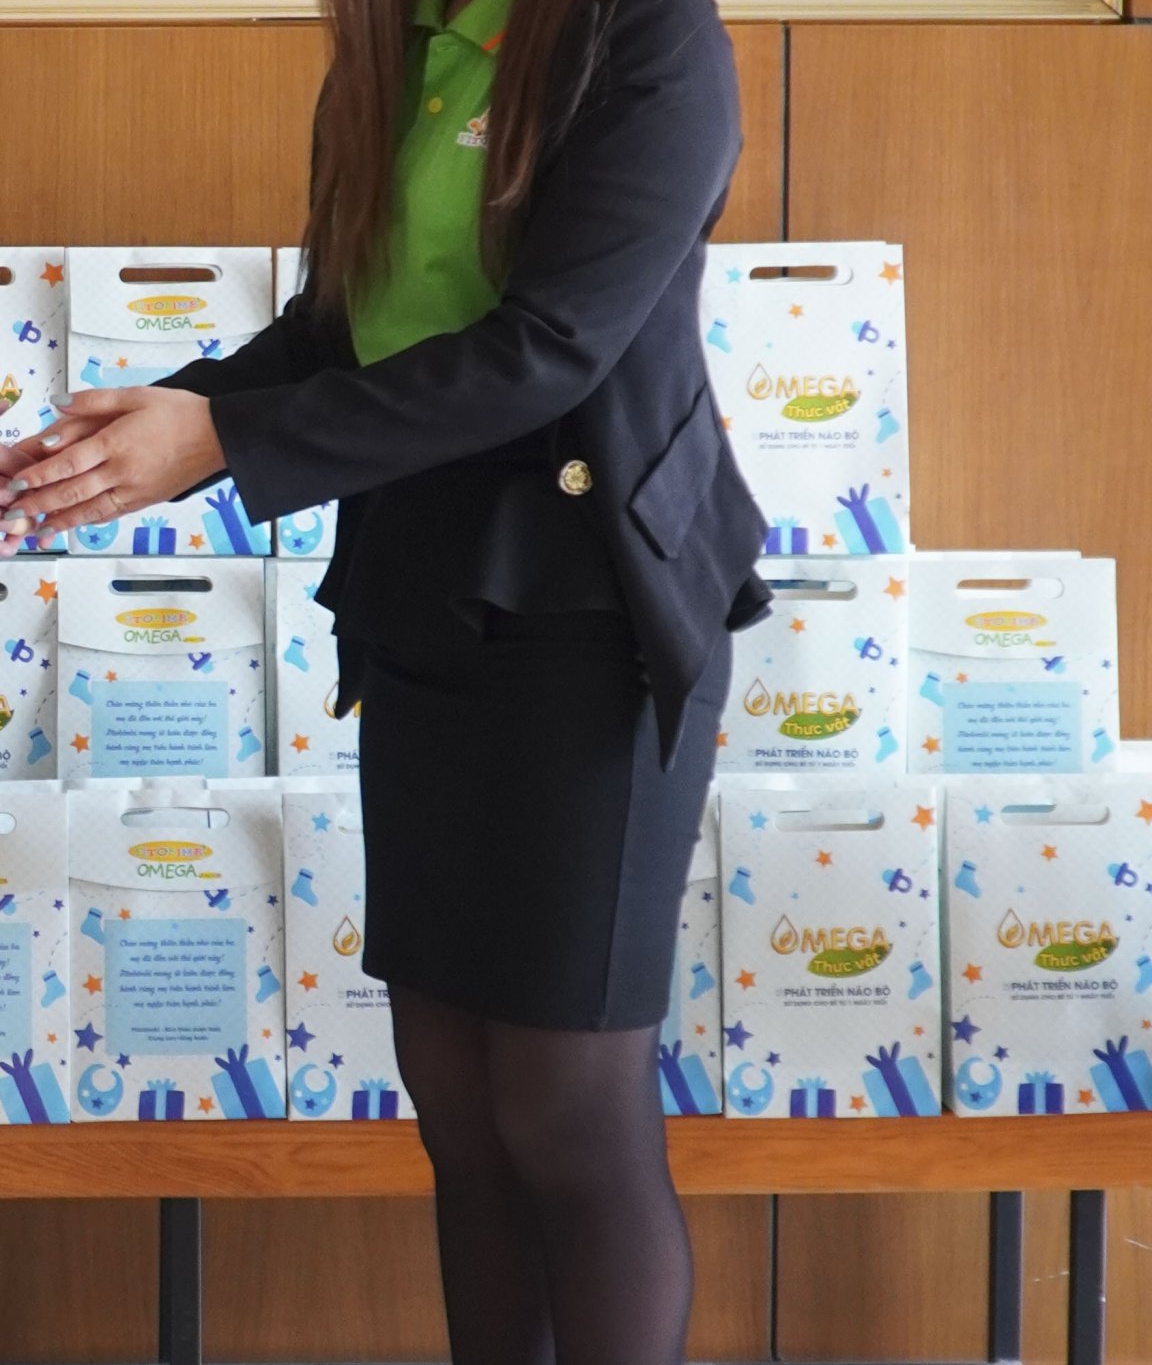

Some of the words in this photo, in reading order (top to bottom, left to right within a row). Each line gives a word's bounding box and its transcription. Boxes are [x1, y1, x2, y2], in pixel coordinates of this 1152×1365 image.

[136, 317, 192, 331] OMEGA
[124, 630, 181, 644] OMEGA
[785, 723, 823, 738] Thực
[337, 749, 359, 760] PHÁ
[137, 864, 198, 879] OMEGA
